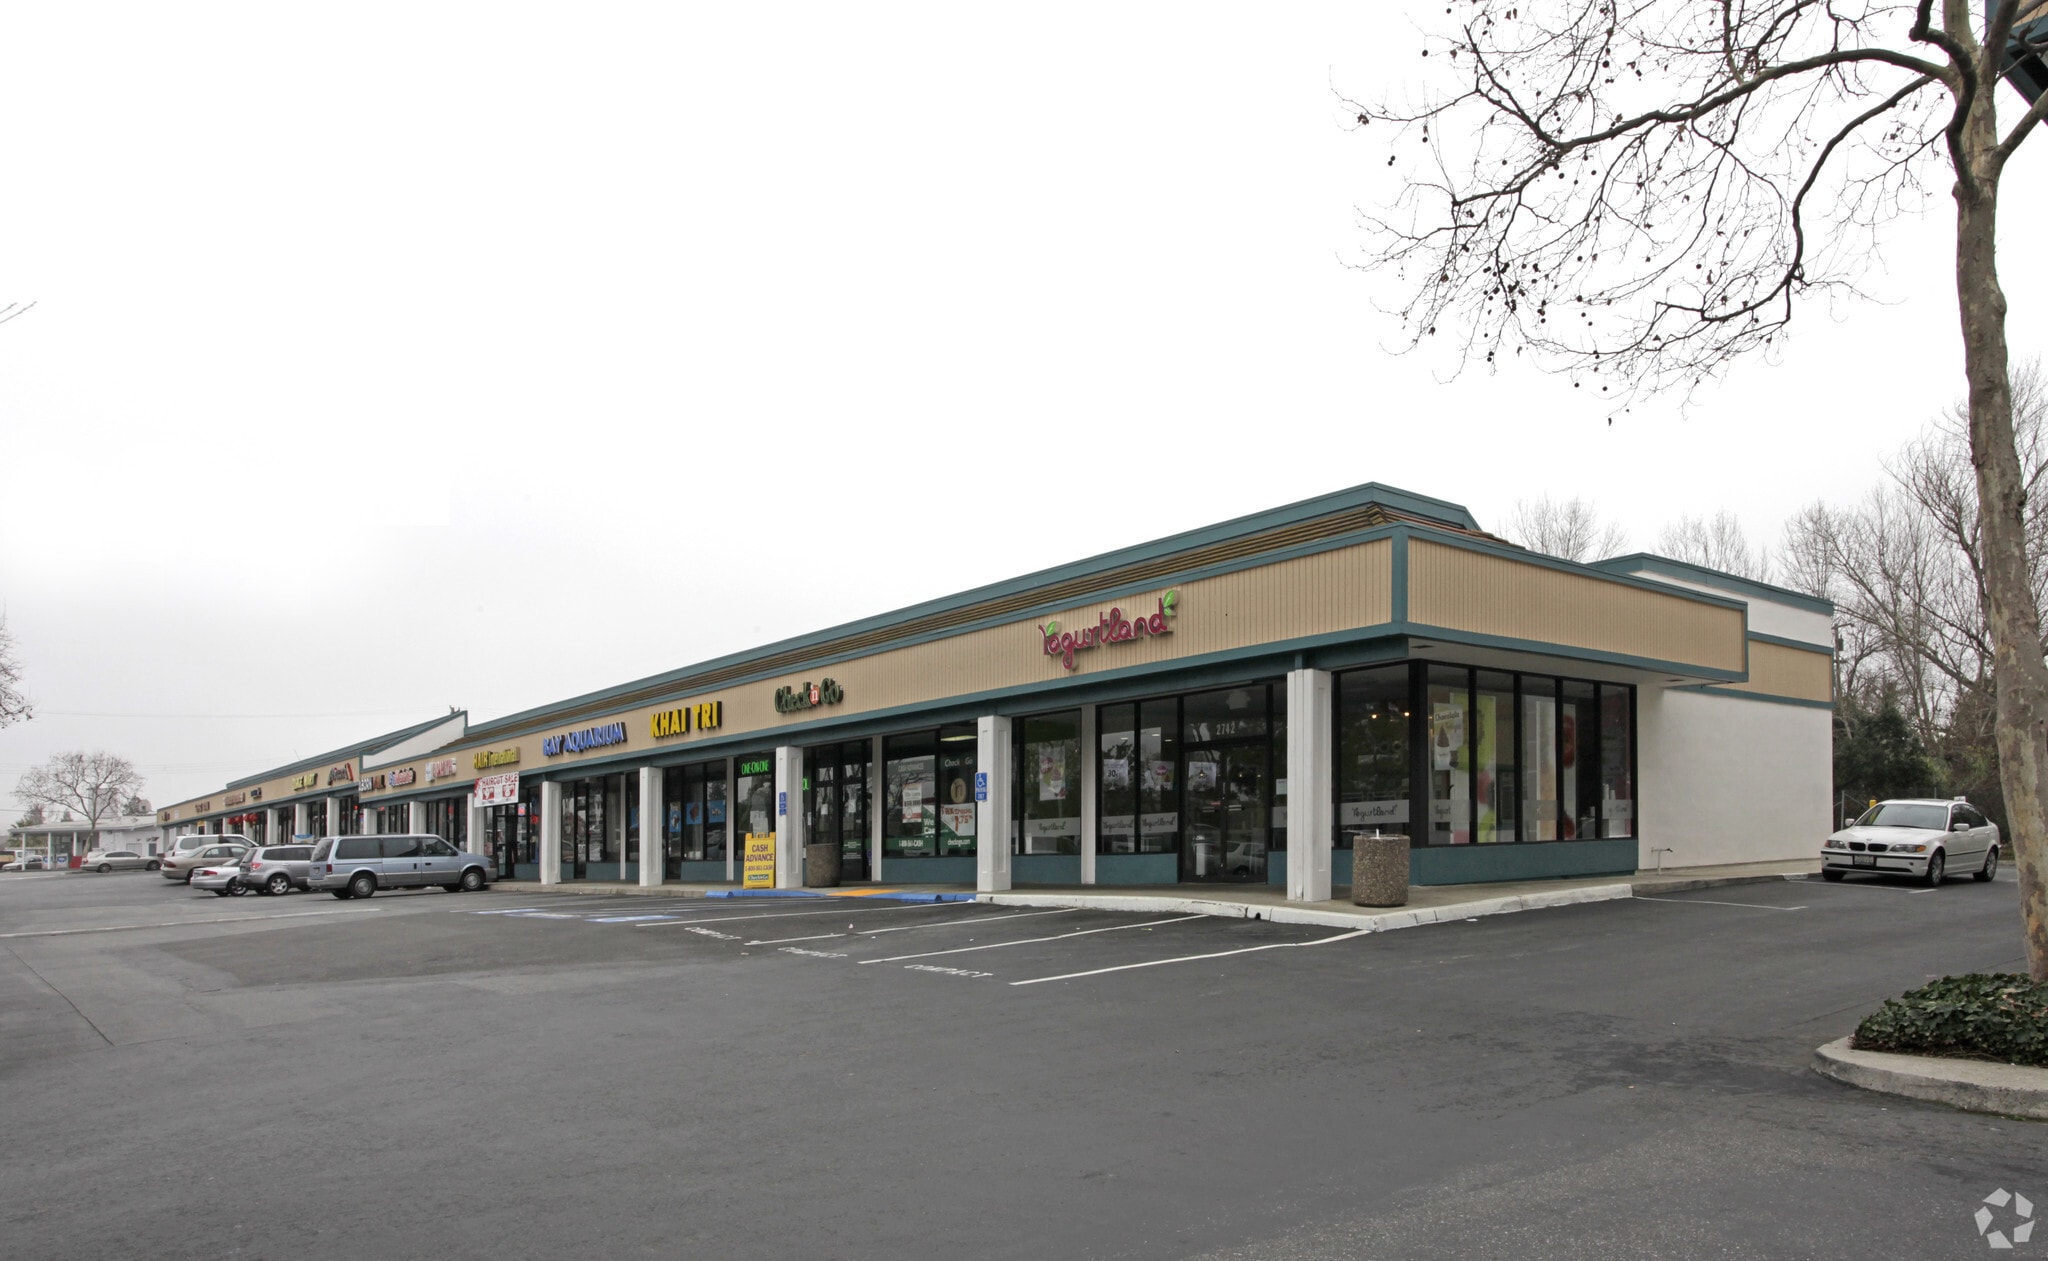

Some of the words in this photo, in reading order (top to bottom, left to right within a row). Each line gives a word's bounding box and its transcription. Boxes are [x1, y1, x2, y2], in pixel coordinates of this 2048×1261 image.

[1038, 597, 1169, 669] Yogurtland
[775, 681, 812, 713] Check
[820, 677, 843, 705] Go
[650, 707, 687, 738] KHAI
[692, 700, 720, 731] TRI
[1216, 721, 1236, 736] 2742
[543, 735, 564, 757] BAY
[564, 721, 626, 754] AQUARIUM
[473, 751, 490, 769] HAIR
[945, 758, 961, 768] Check
[1352, 804, 1399, 821] Yogurtland
[752, 844, 769, 853] CASH
[745, 853, 774, 863] ADVANCE
